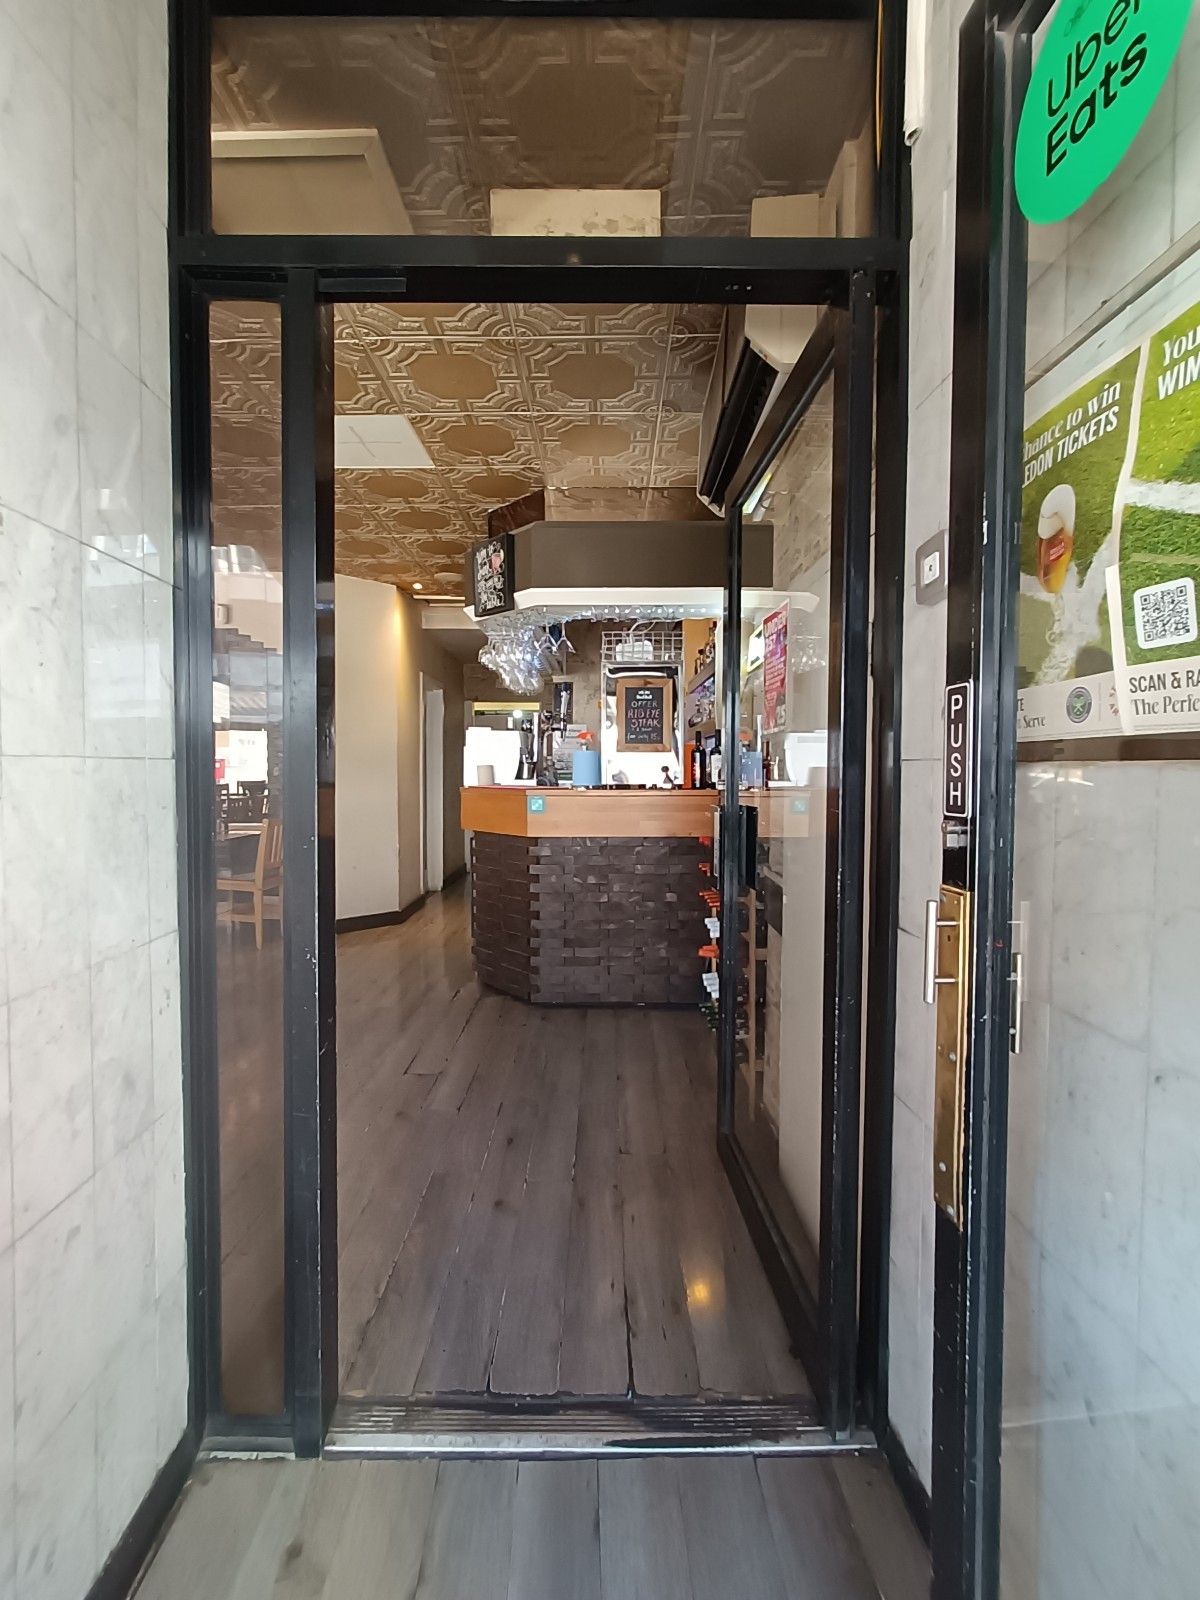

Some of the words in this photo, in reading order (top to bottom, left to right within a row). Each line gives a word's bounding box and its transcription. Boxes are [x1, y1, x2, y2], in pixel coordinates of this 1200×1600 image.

[1047, 0, 1140, 118] Ube
[1046, 32, 1148, 177] Eats
[1022, 446, 1054, 488] EDON
[1057, 406, 1119, 463] TICKETS
[1023, 420, 1064, 462] hance
[1066, 407, 1082, 431] to
[1087, 382, 1121, 417] win
[631, 700, 658, 708] OFFER
[1129, 673, 1167, 693] SCAN
[1171, 671, 1181, 689] &
[1130, 698, 1160, 716] The
[1163, 693, 1200, 713] Perfe
[630, 718, 661, 728] STEAK
[1023, 714, 1046, 729] Serve
[950, 694, 963, 806] PUSH
